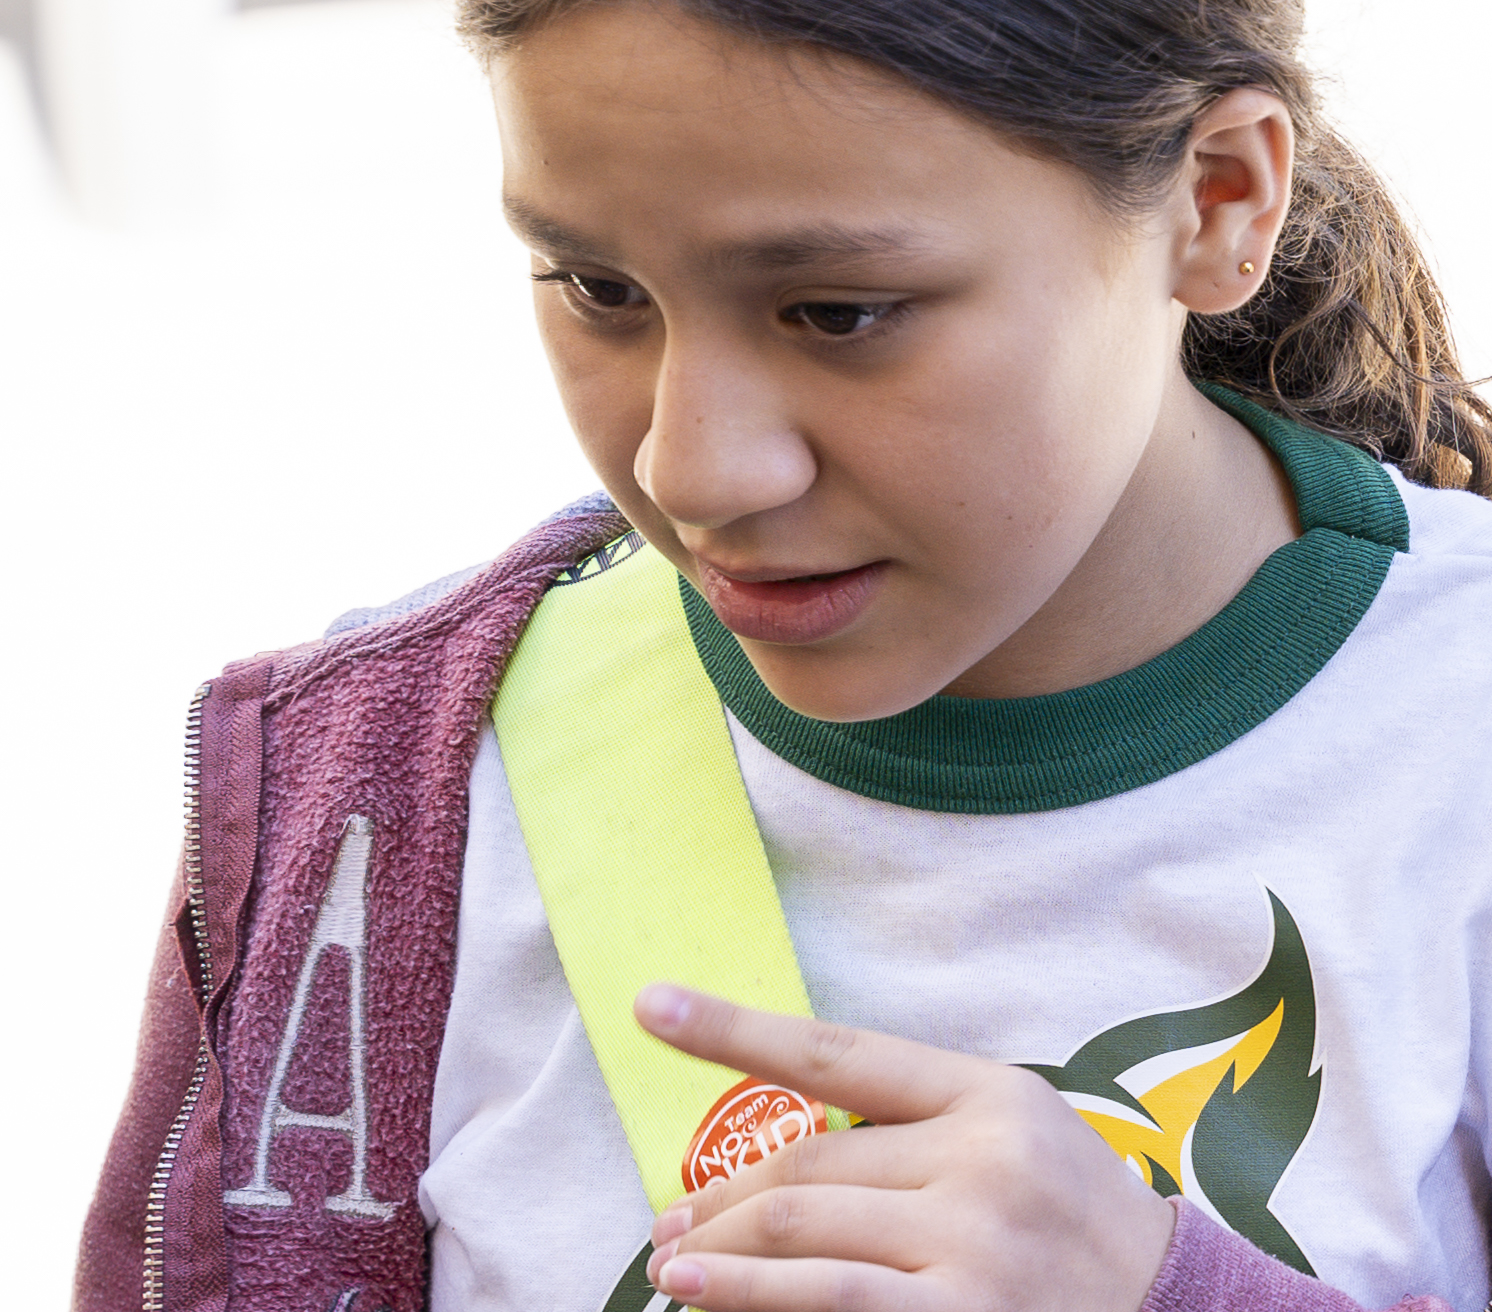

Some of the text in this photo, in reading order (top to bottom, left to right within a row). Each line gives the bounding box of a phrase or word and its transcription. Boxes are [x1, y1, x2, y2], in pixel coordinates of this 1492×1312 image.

[725, 1093, 769, 1132] Team
[699, 1132, 743, 1177] NO
[722, 1110, 808, 1179] KID
